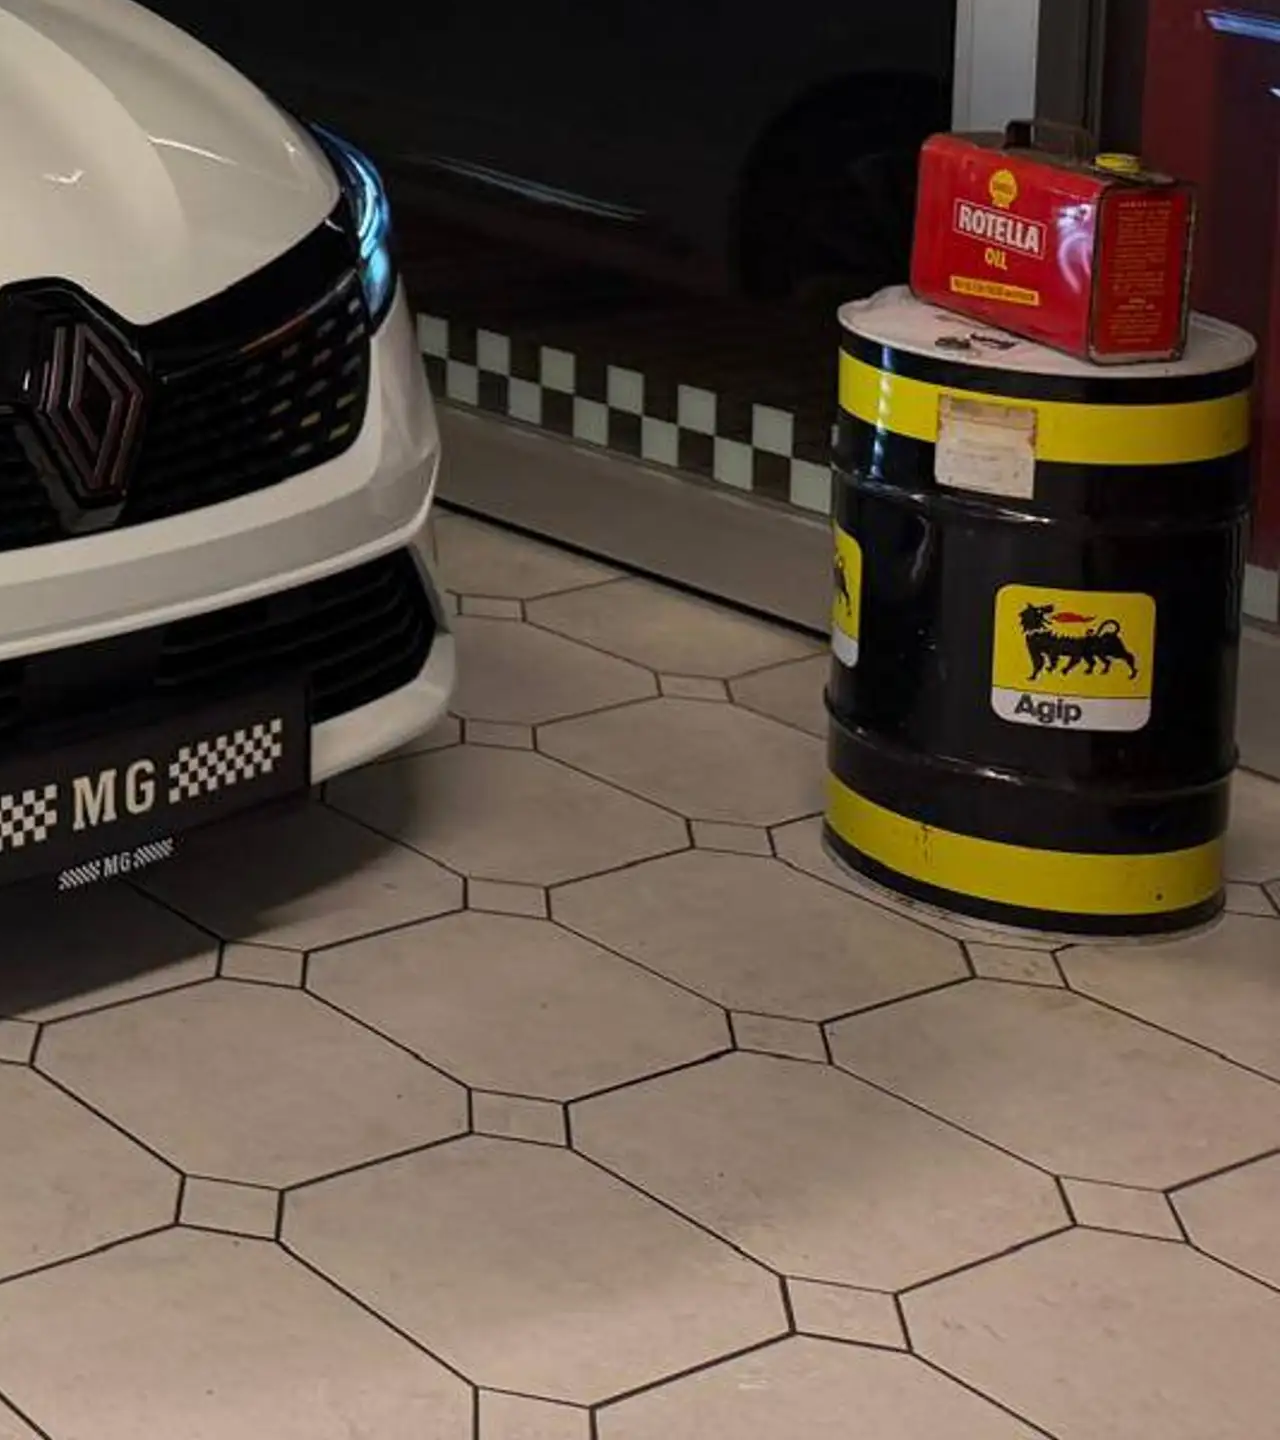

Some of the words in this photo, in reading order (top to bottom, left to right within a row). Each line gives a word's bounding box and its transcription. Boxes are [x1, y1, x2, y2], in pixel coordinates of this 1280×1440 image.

[958, 203, 1040, 254] ROTELLA
[984, 247, 1008, 271] OIL
[1013, 693, 1083, 725] Agip
[72, 758, 156, 832] MG
[103, 851, 131, 877] MG
